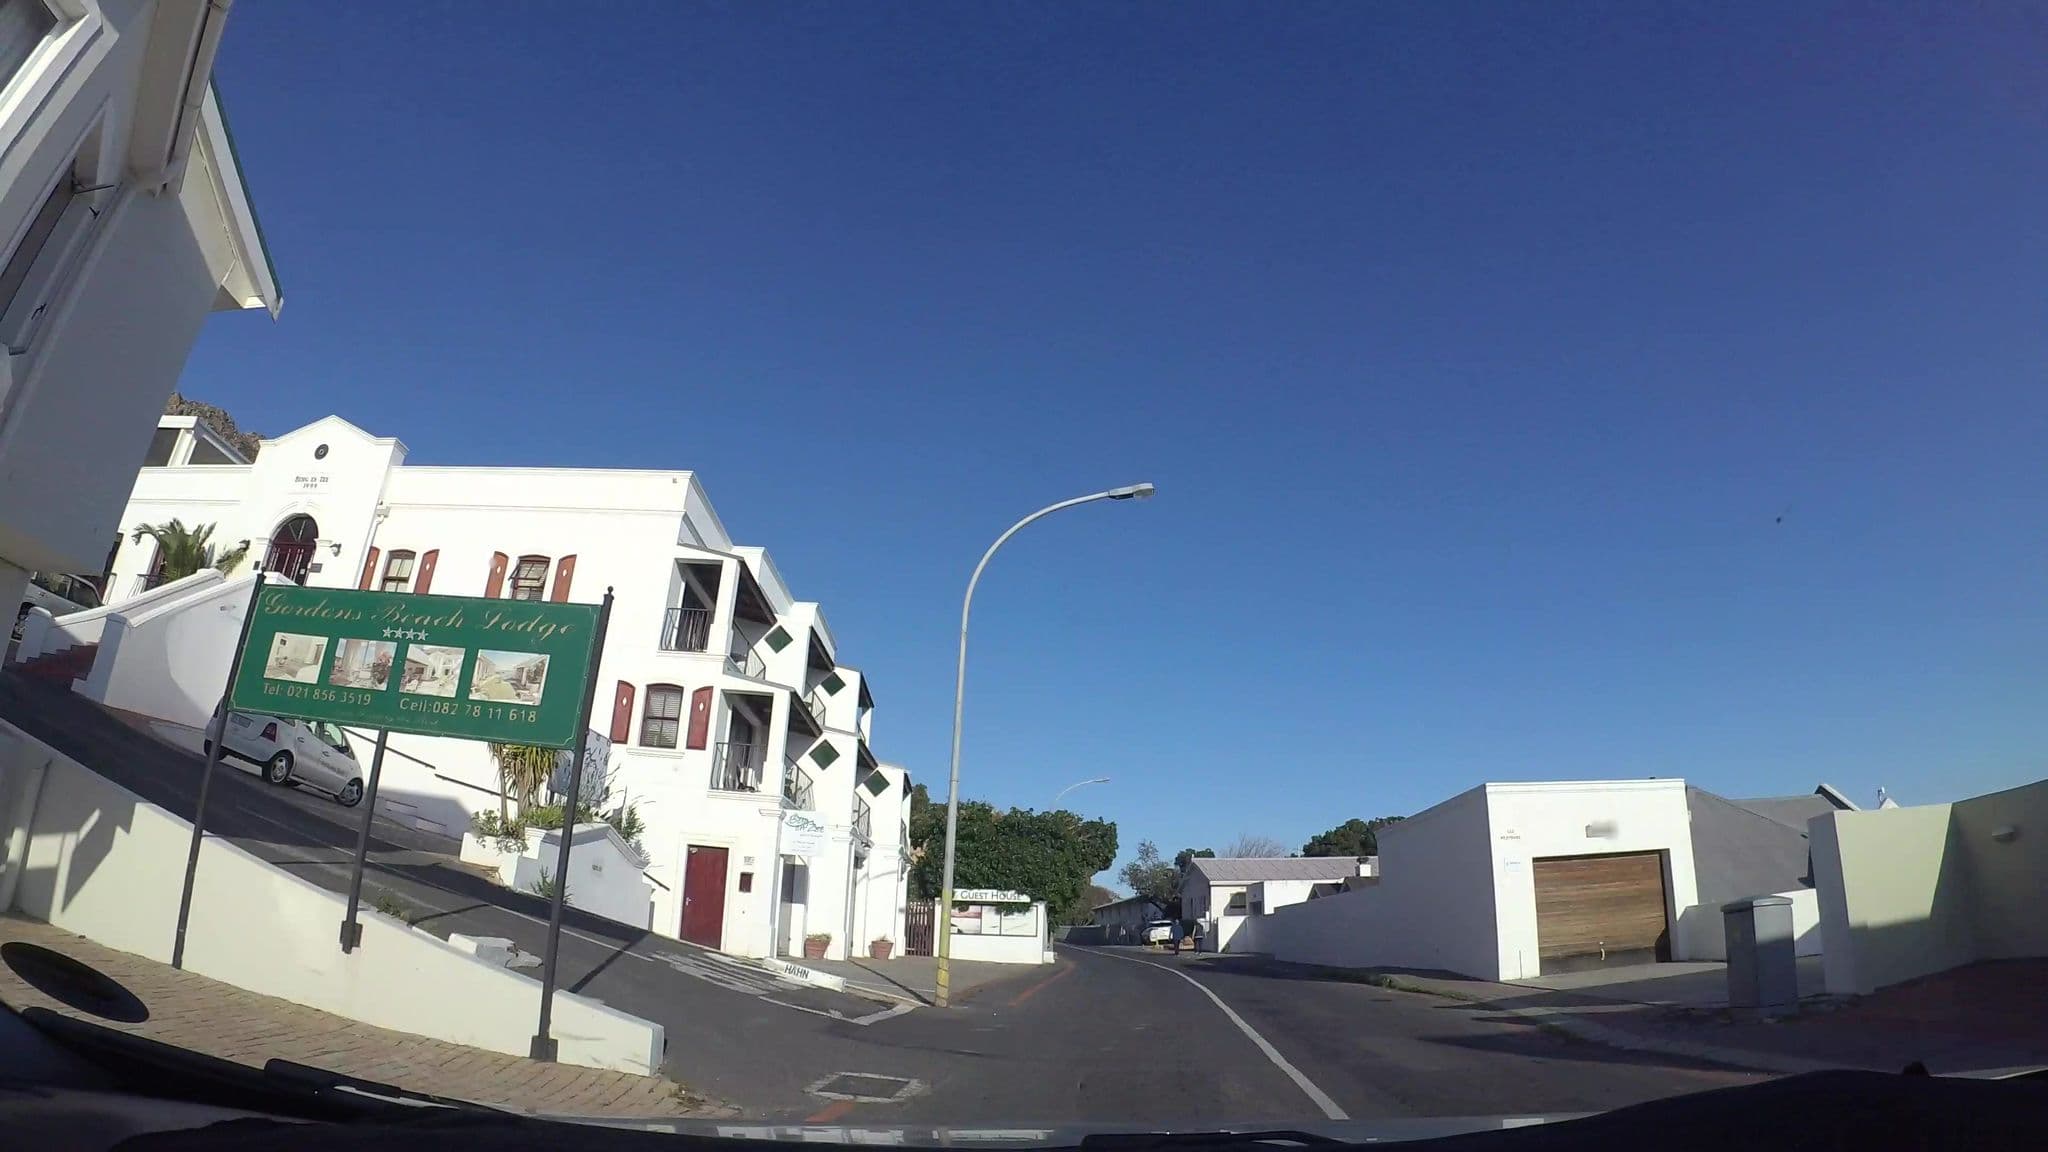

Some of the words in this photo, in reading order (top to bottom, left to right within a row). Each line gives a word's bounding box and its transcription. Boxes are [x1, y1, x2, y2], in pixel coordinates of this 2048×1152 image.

[264, 592, 363, 621] Gordons
[370, 602, 465, 629] Beach
[482, 608, 577, 641] Lodge
[263, 682, 283, 695] Tel:
[286, 685, 309, 699] 021
[312, 688, 336, 702] 856
[340, 691, 372, 706] 3519
[464, 704, 482, 718] 78
[487, 707, 503, 720] 11
[508, 708, 538, 724] 618
[784, 964, 810, 980] HAHN
